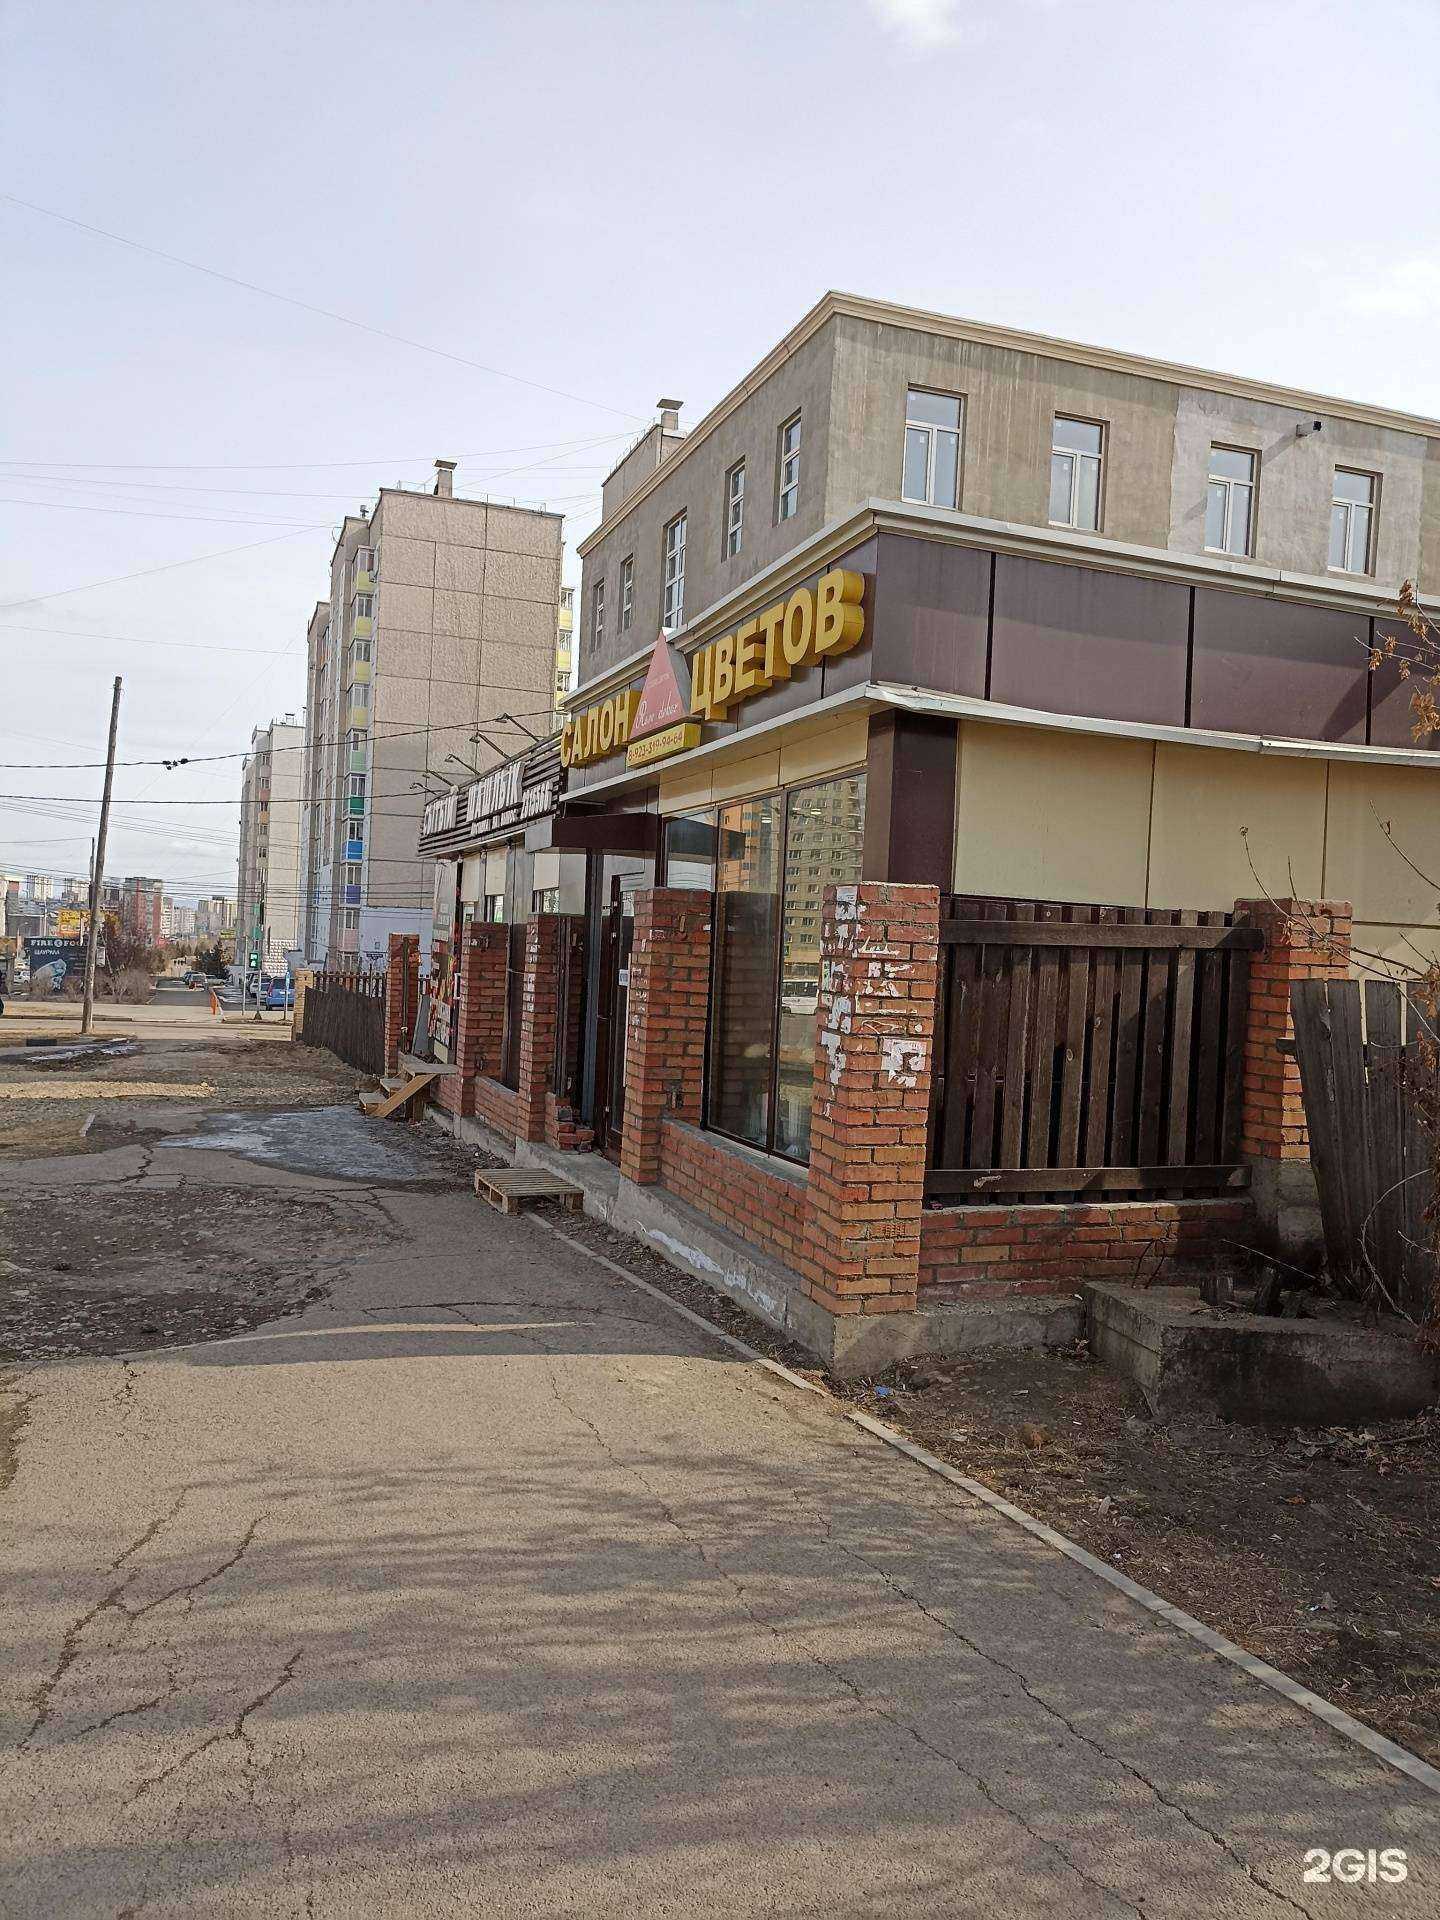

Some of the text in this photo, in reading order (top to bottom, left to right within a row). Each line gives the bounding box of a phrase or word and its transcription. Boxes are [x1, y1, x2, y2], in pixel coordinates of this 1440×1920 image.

[560, 568, 865, 768] САЛОН ЦВЕТОВ
[30, 939, 54, 947] FIRE
